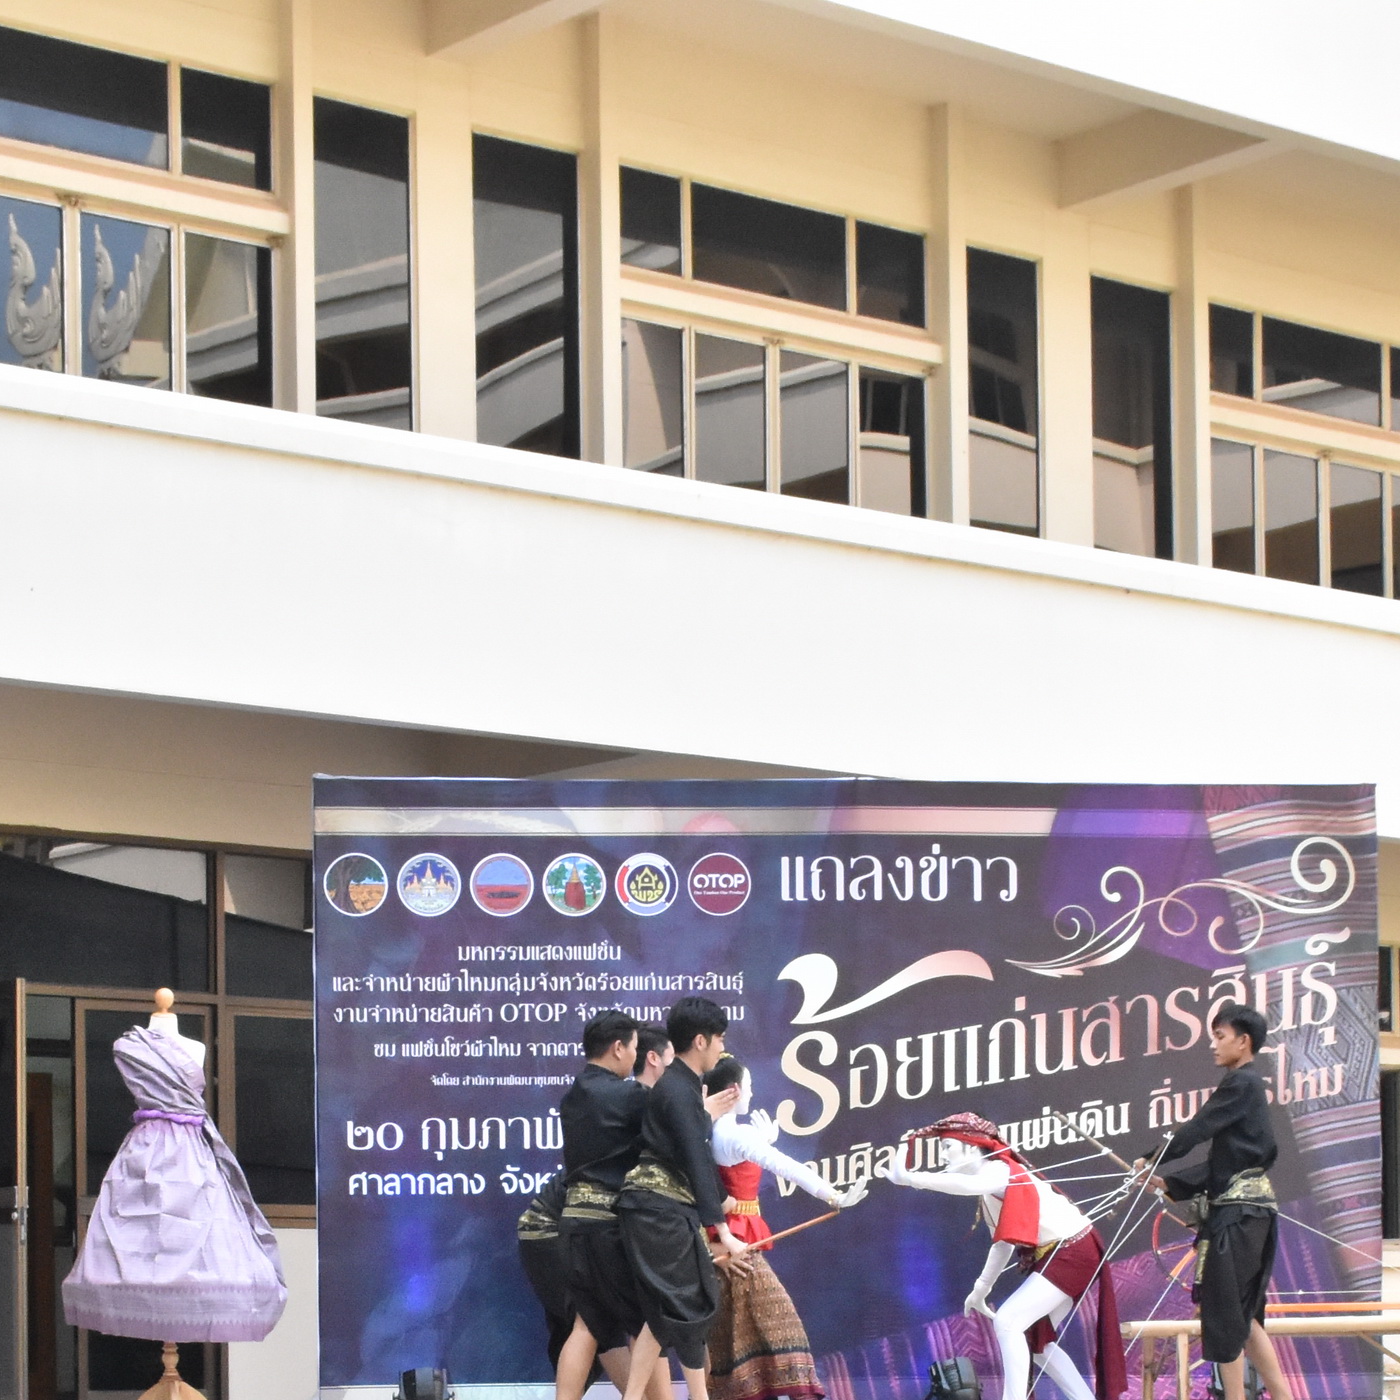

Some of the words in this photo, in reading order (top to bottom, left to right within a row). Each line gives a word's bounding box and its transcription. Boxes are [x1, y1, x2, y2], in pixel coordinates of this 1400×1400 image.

[693, 873, 745, 889] OTOP
[780, 843, 1018, 902] แถลงข่าว
[457, 940, 622, 961] มหกรรมแสดงแฟชั่น
[333, 1003, 493, 1023] งานจำหน่ายสินค้า
[499, 1002, 568, 1023] OTOP
[373, 1042, 397, 1058] ชม
[401, 1035, 522, 1058] แฟชั่นโชว์ผ้าไหม
[346, 1120, 404, 1151] ๒๐
[348, 1171, 486, 1196] ศาลากลาง
